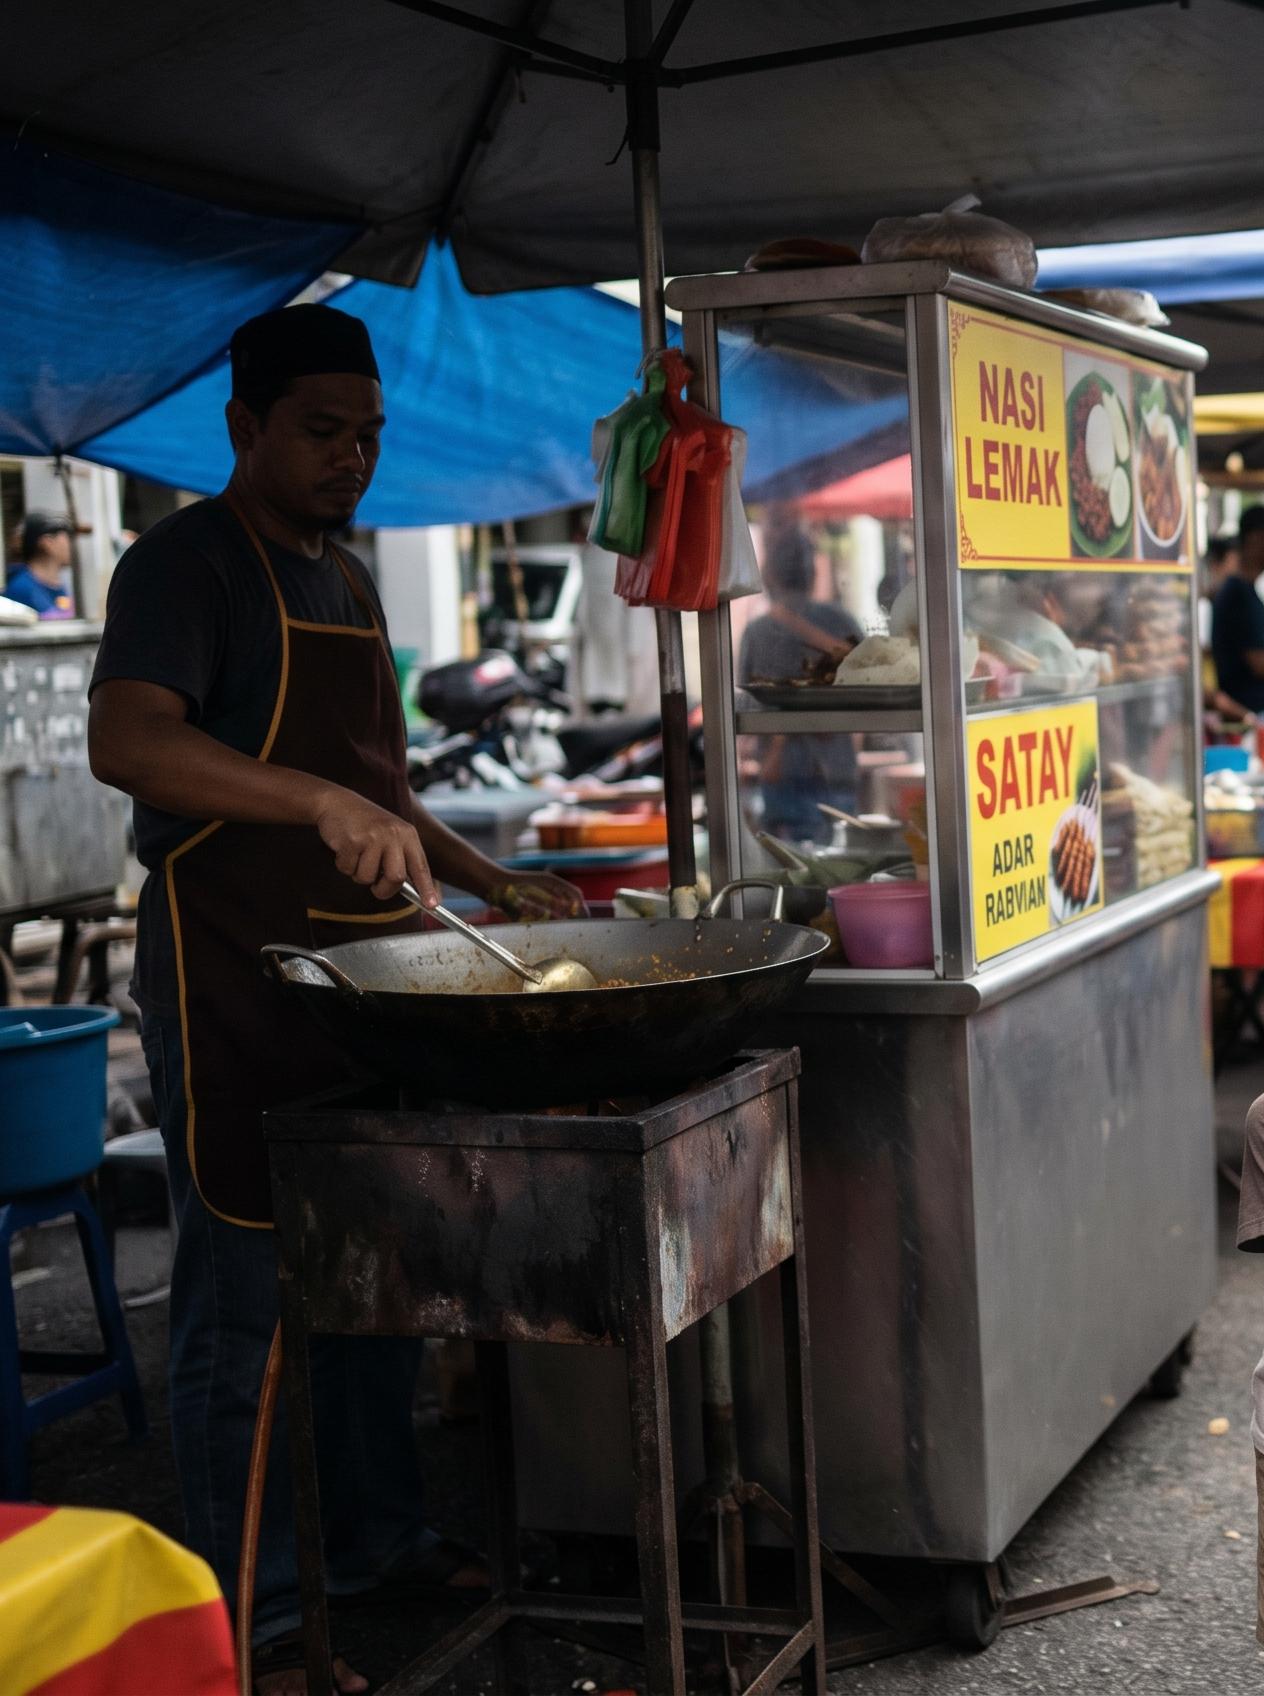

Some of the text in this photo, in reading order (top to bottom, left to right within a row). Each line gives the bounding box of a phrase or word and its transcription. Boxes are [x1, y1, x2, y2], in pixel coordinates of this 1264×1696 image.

[978, 360, 1045, 433] NASI
[965, 436, 1062, 508] LEMAK
[976, 724, 1074, 820] SATAY
[992, 832, 1035, 878] ADAR
[985, 874, 1047, 928] RABVIAN
